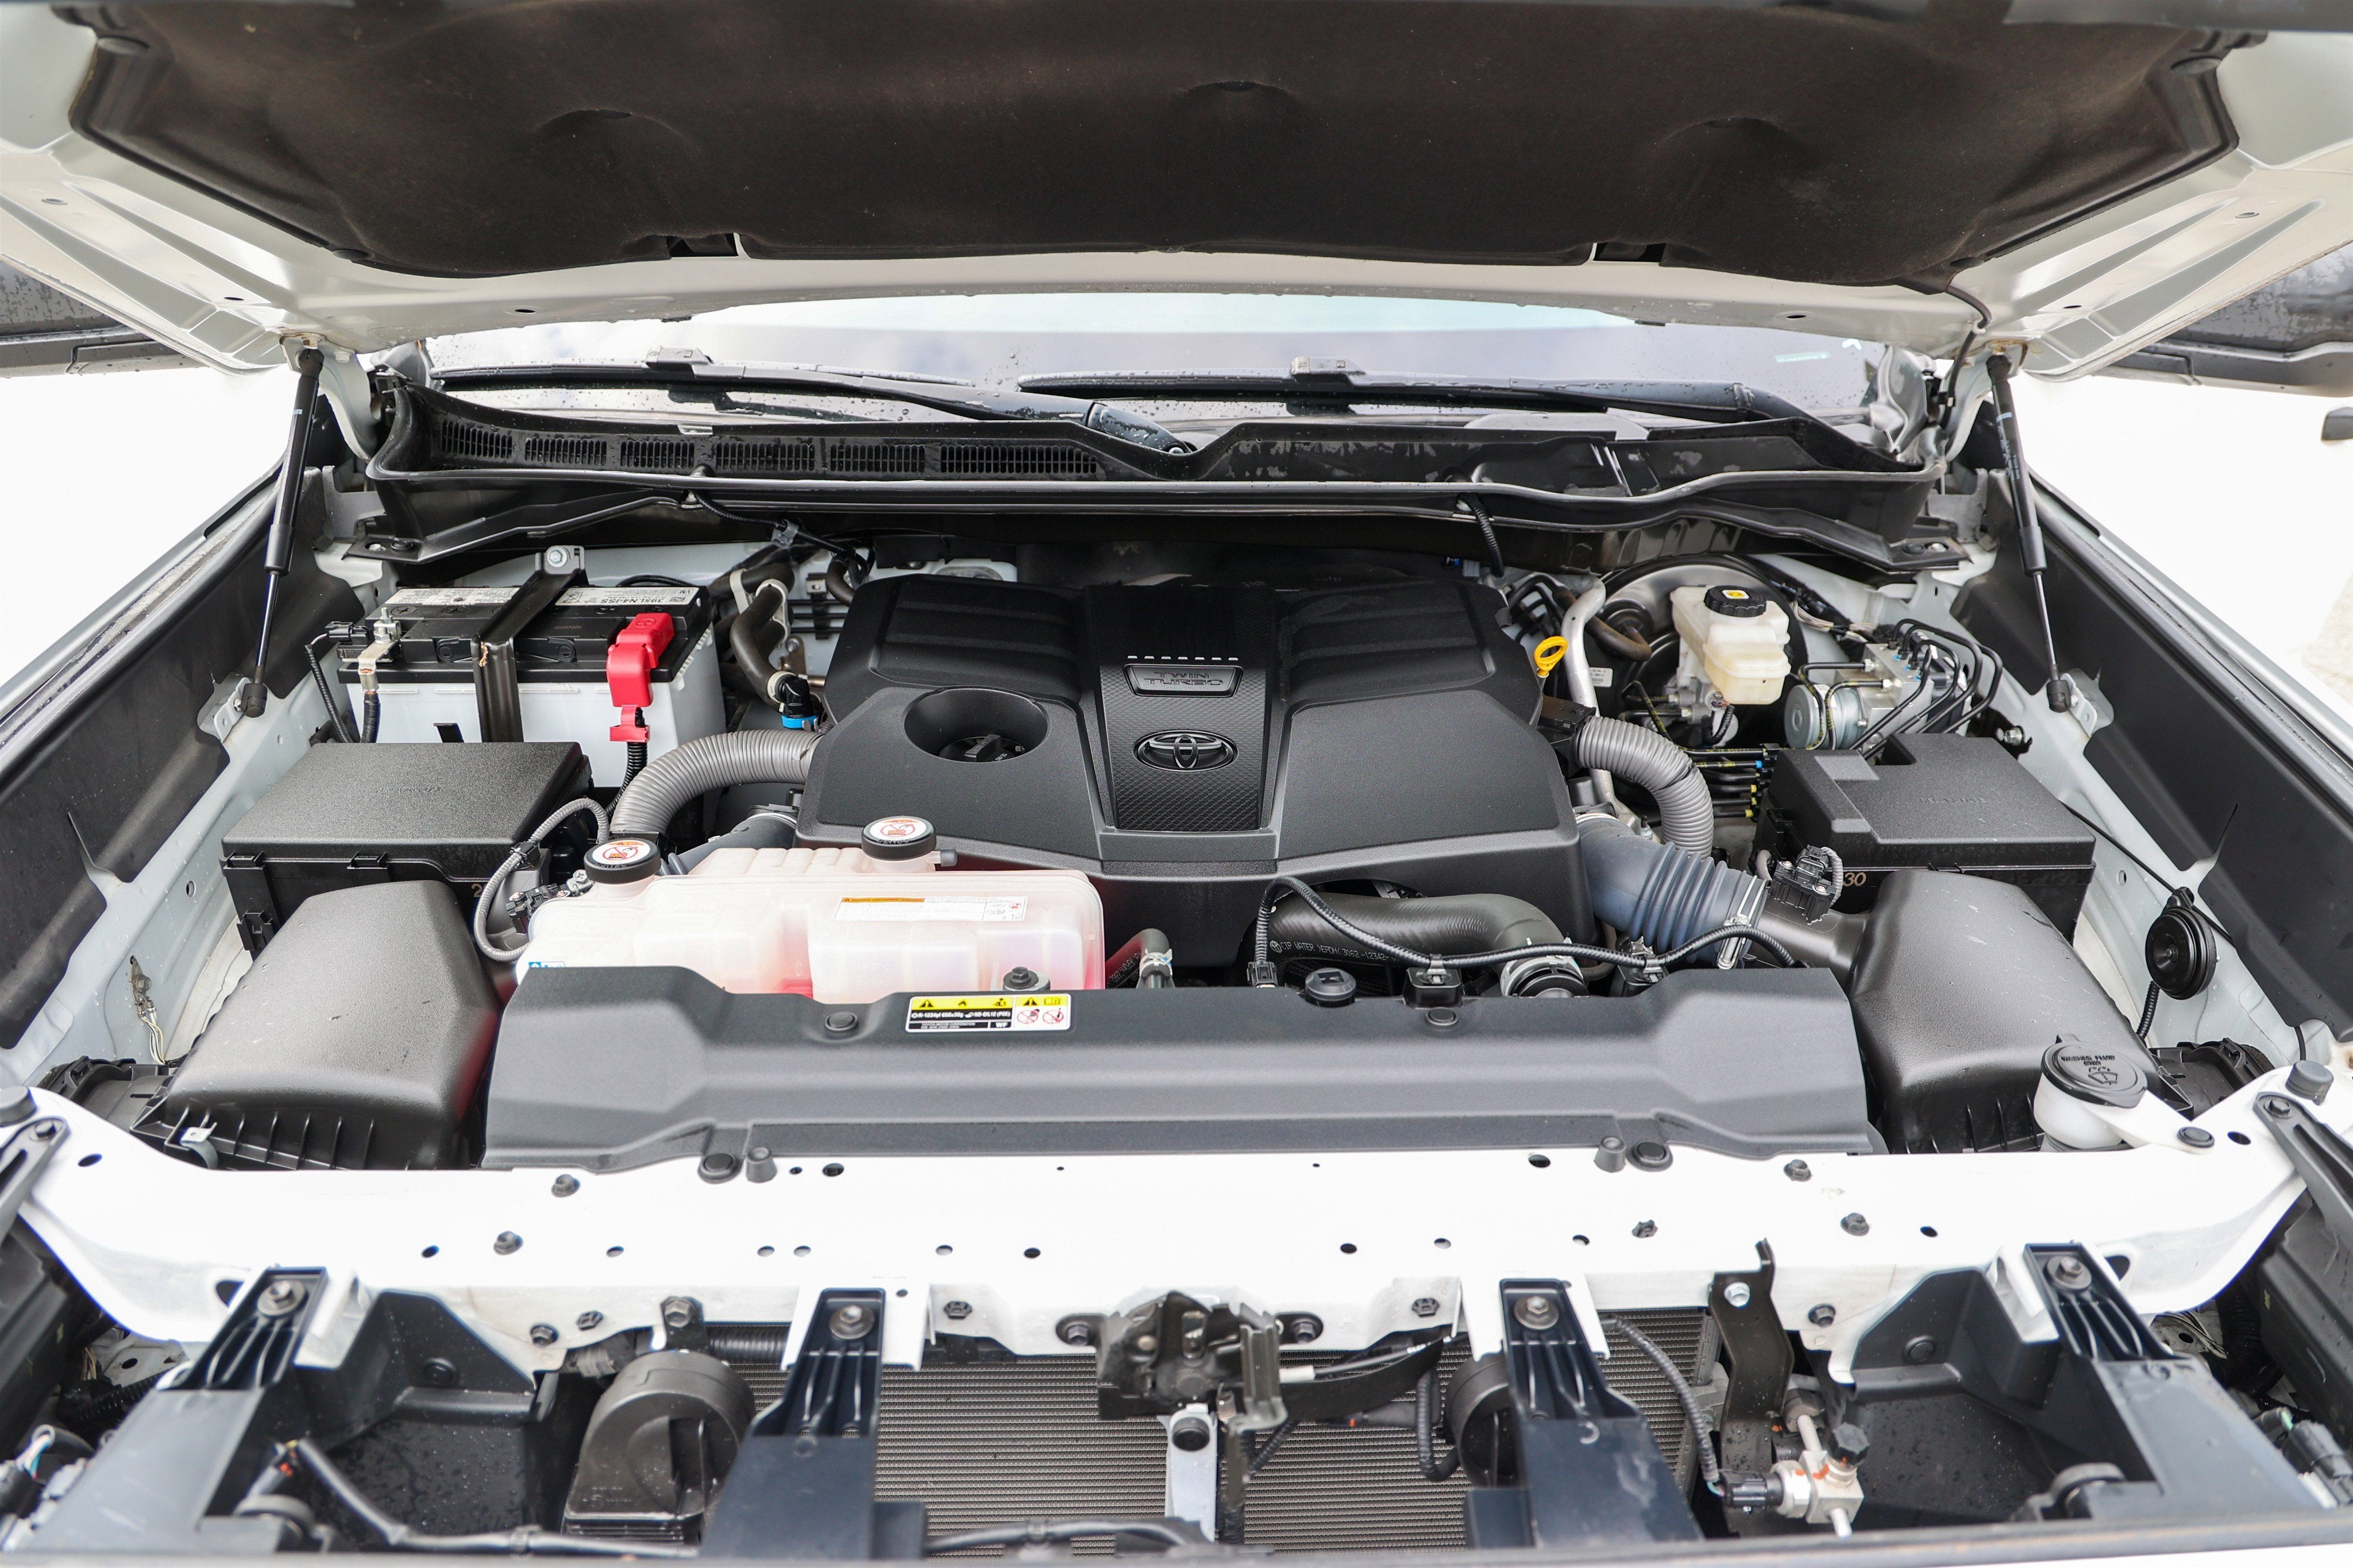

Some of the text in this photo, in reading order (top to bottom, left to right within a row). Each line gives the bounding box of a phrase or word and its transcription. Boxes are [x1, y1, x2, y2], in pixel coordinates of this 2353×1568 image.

[1144, 678, 1224, 686] TURBO
[471, 883, 488, 898] 2
[1294, 941, 1316, 952] WATER
[1341, 948, 1360, 958] 3062
